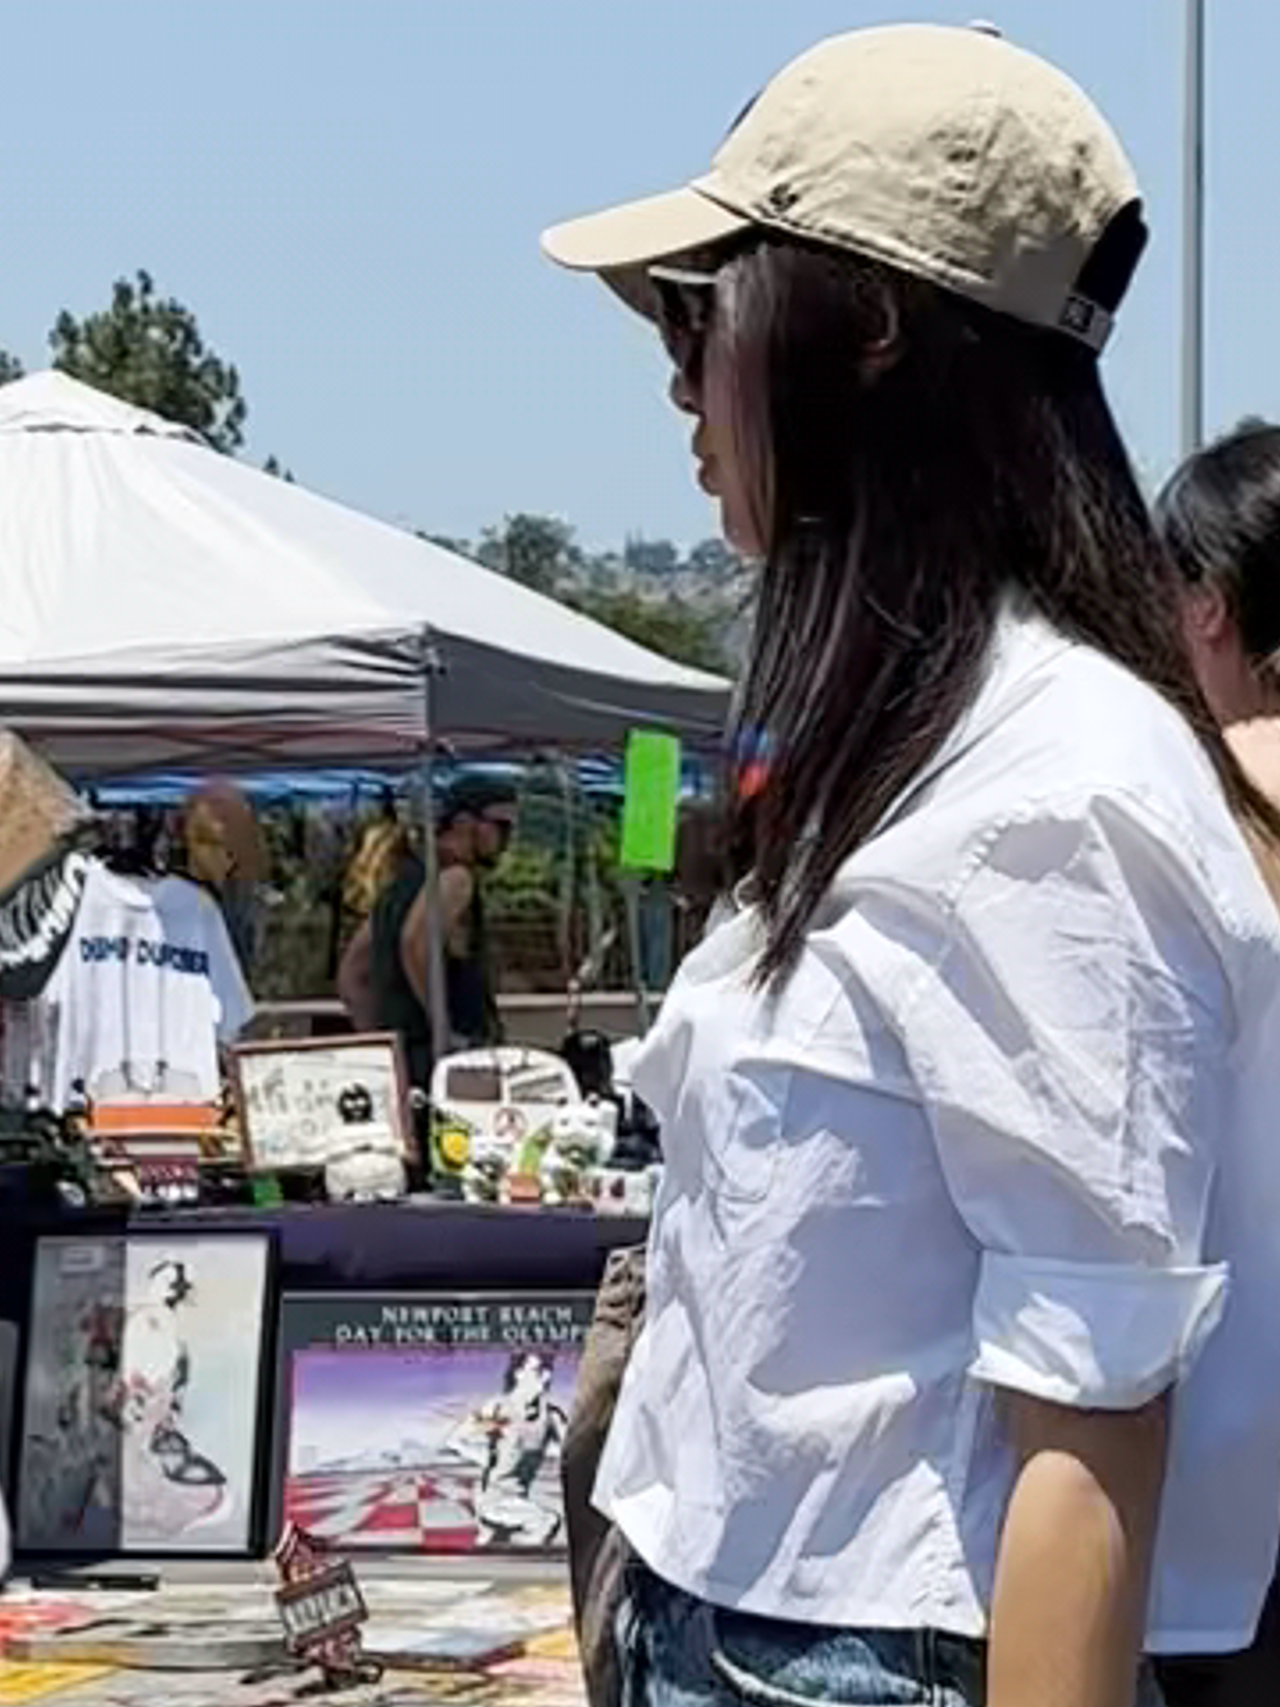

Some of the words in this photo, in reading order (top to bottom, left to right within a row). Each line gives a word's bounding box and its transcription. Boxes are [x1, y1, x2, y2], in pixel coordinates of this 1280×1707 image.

[381, 1306, 488, 1324] NEWPORT
[499, 1306, 572, 1324] BEACH
[335, 1323, 384, 1342] DAY
[396, 1324, 434, 1342] FOR
[451, 1324, 490, 1342] THE
